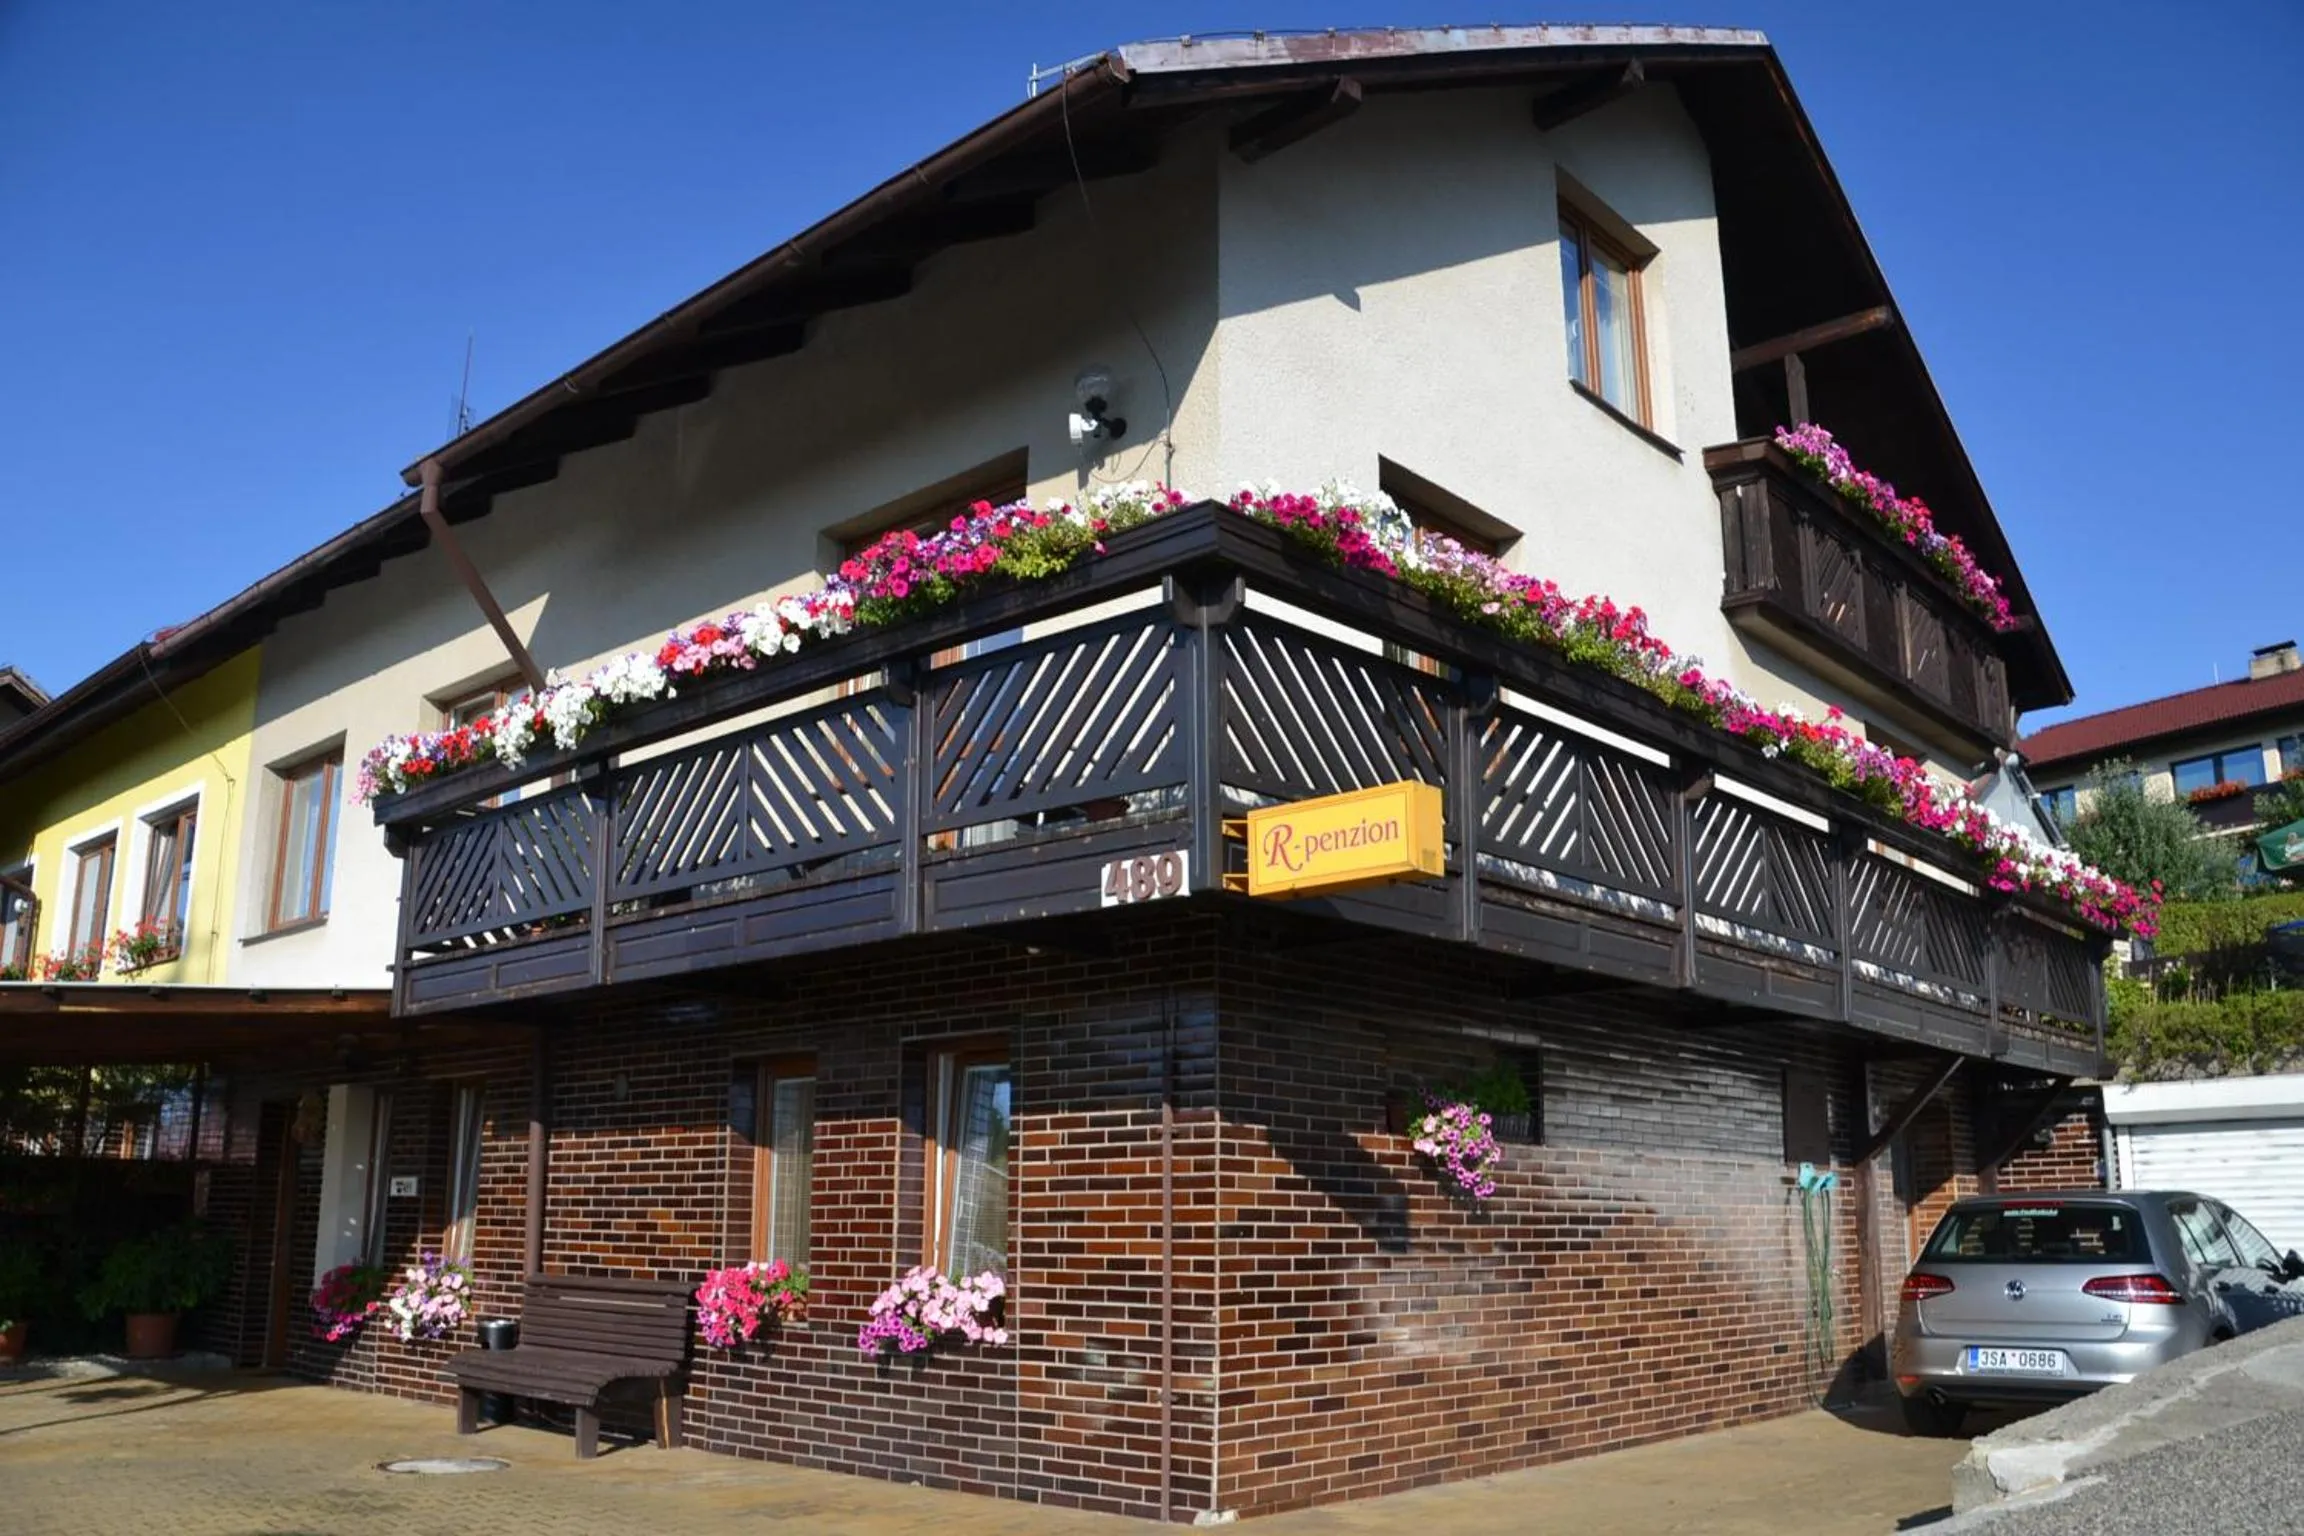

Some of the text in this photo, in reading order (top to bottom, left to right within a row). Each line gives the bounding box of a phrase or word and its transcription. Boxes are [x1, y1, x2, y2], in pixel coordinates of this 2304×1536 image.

[1104, 850, 1183, 904] 489
[1981, 1351, 2056, 1368] 3SA 0686
